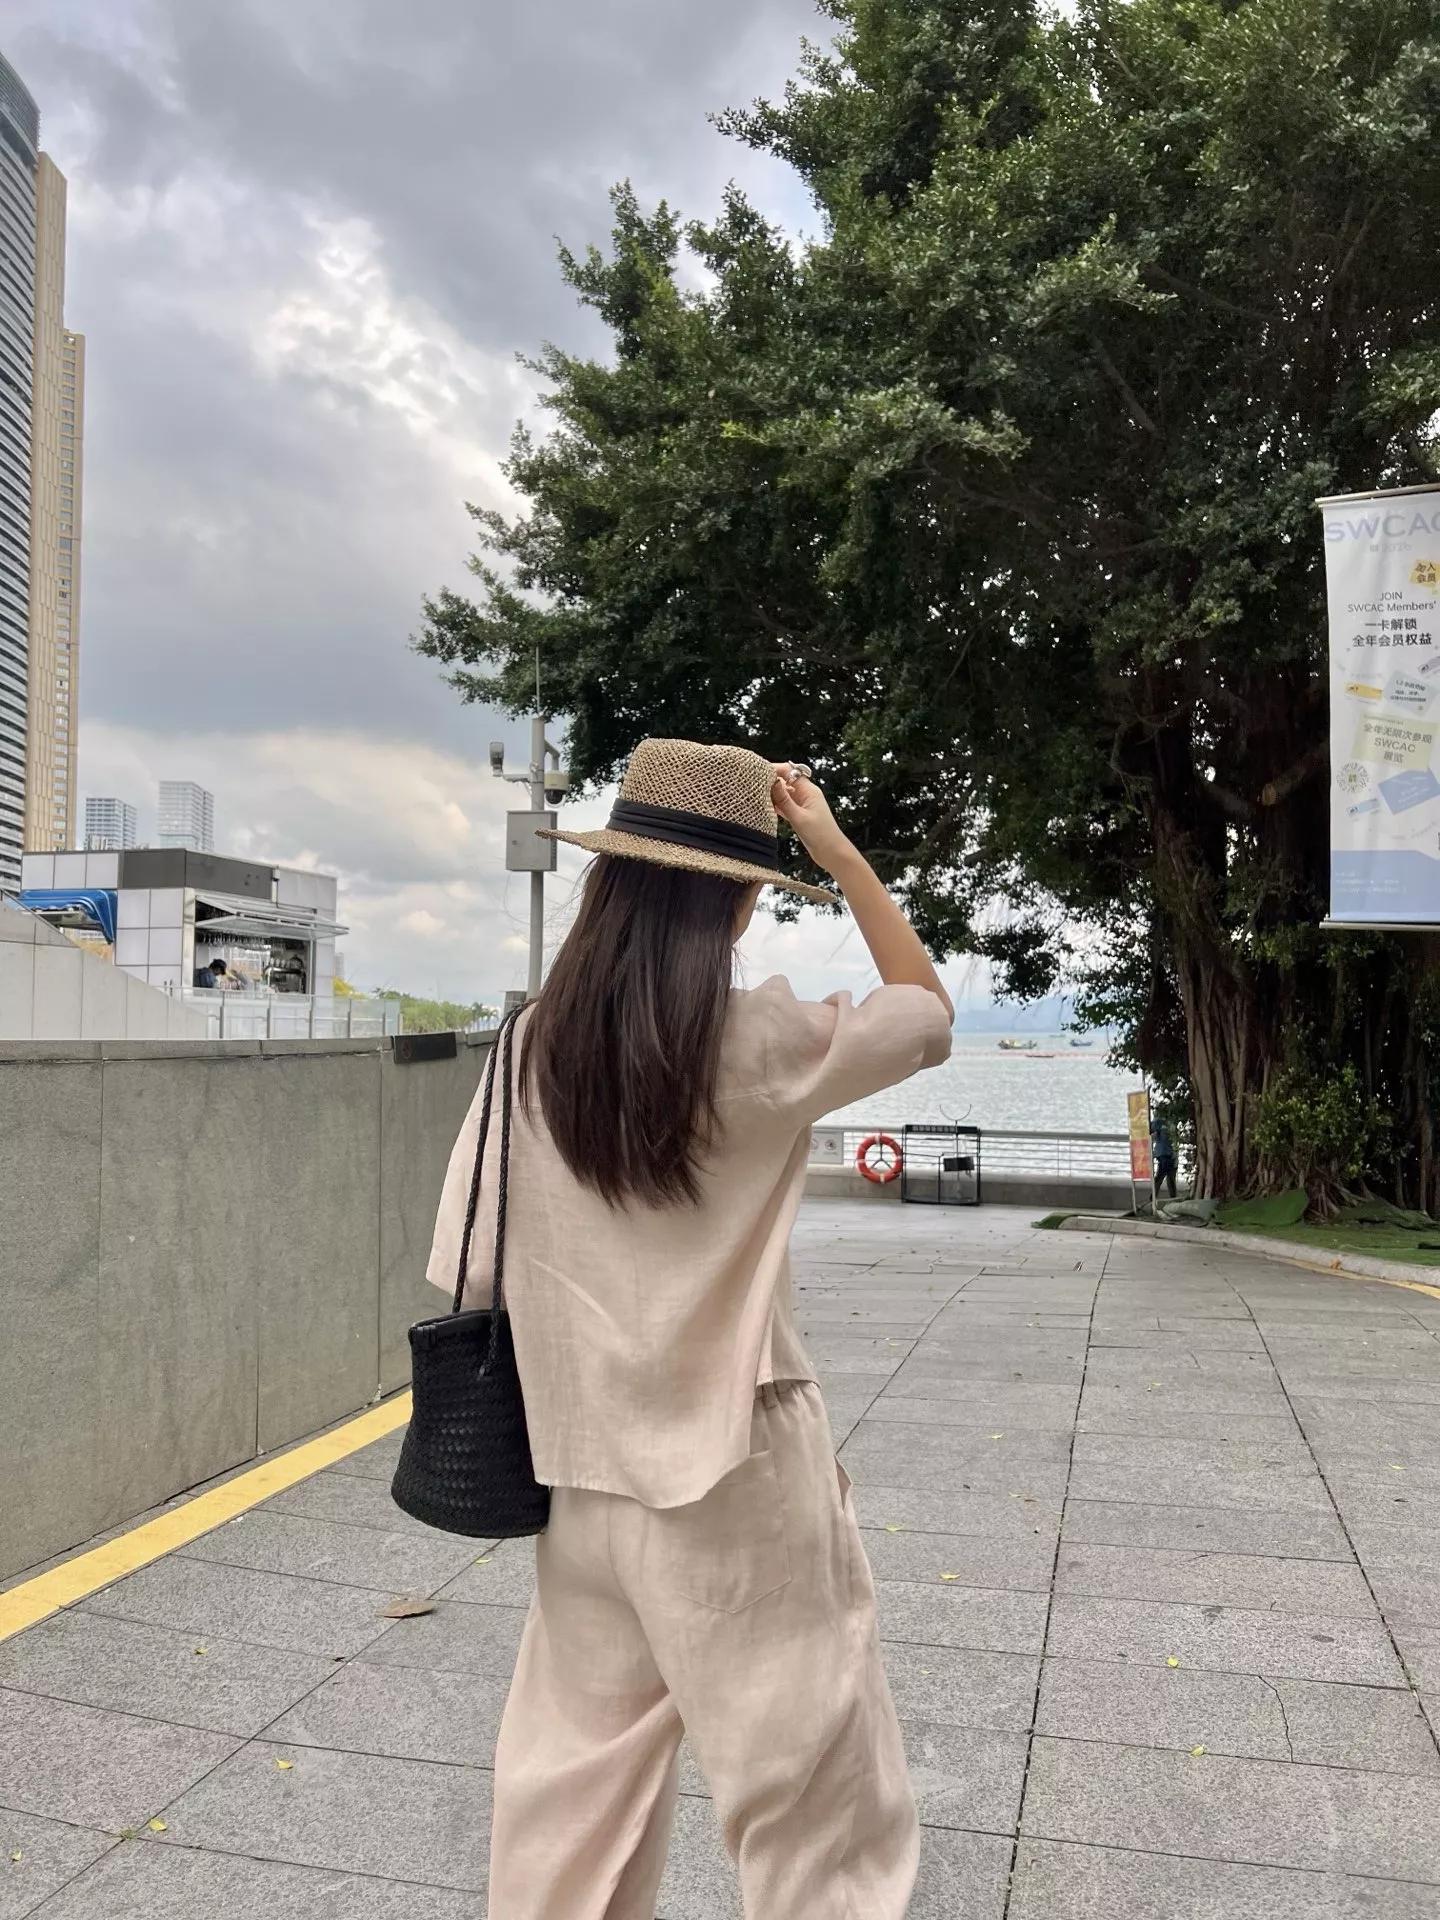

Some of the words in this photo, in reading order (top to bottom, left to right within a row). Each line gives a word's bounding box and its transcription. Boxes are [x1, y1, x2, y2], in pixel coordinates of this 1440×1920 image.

[1416, 573, 1436, 584] 会员
[1379, 591, 1403, 602] JOIN
[1347, 603, 1384, 612] SWCAC
[1364, 617, 1418, 631] 一卡解锁
[1352, 632, 1432, 647] 全年会员权益
[1363, 723, 1433, 744] 全年无限次参观
[1373, 737, 1416, 753] SWCAC
